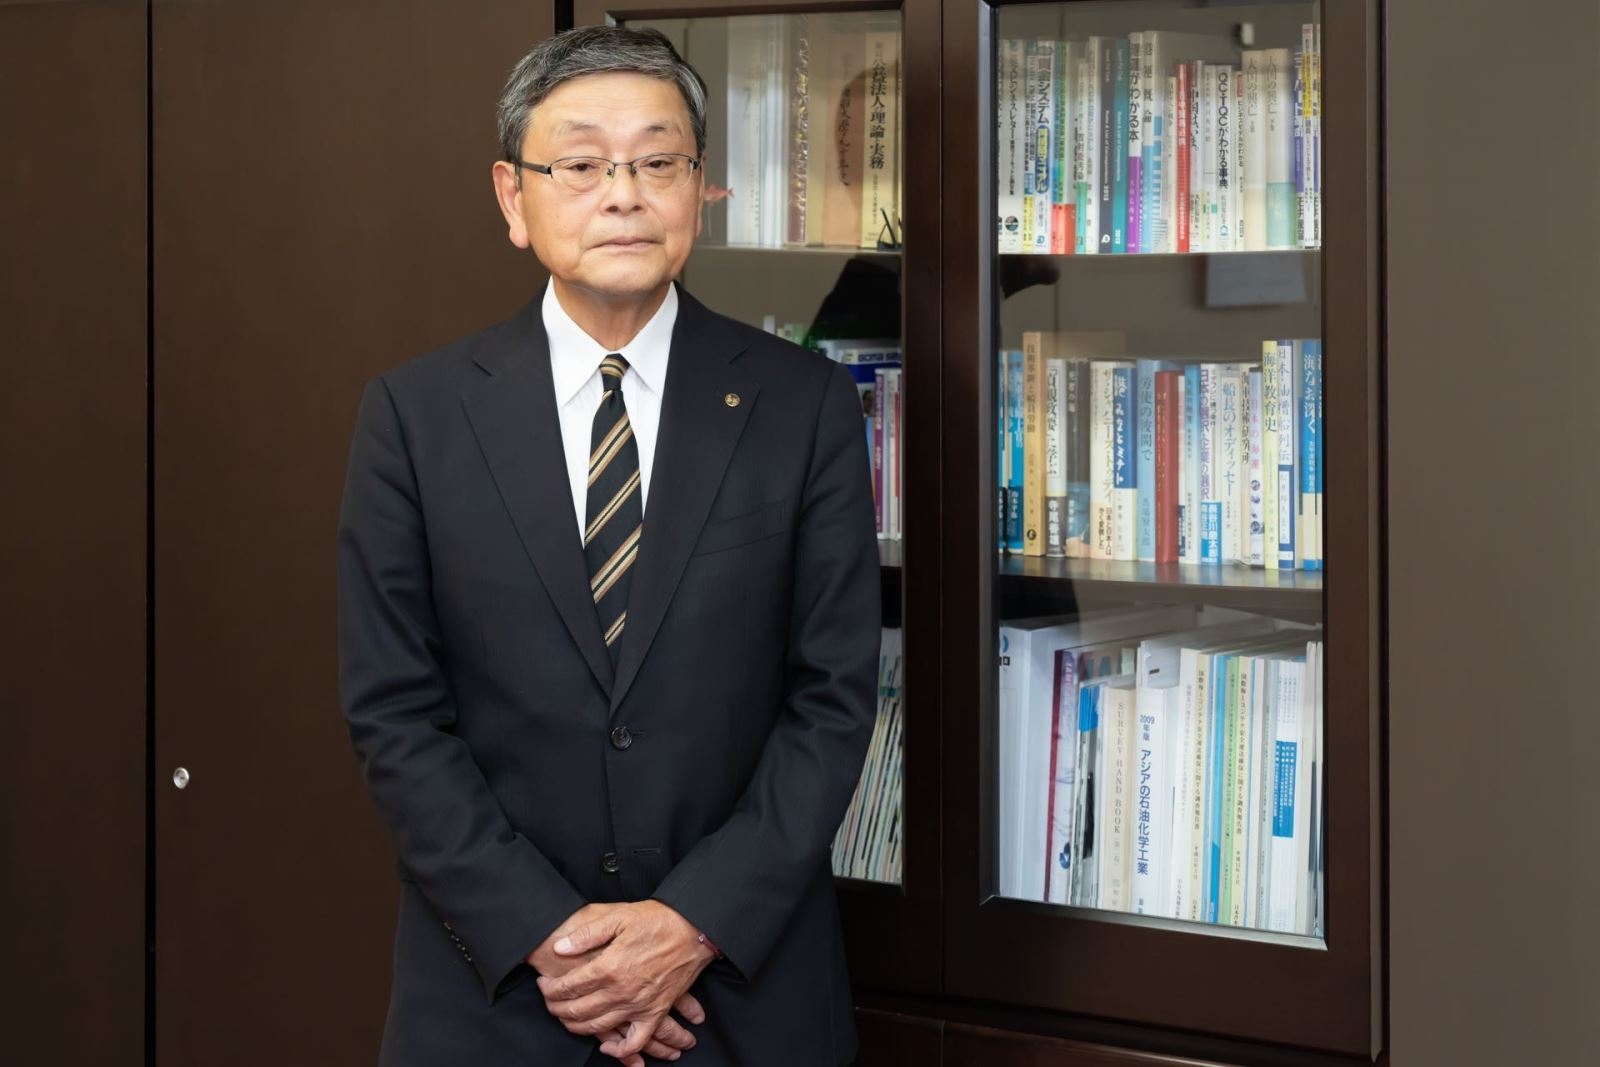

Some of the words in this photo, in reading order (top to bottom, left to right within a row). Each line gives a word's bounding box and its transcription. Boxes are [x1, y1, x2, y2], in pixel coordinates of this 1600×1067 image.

[1113, 799, 1122, 834] BOOK
[1137, 749, 1152, 875] アジアの石油化学工業
